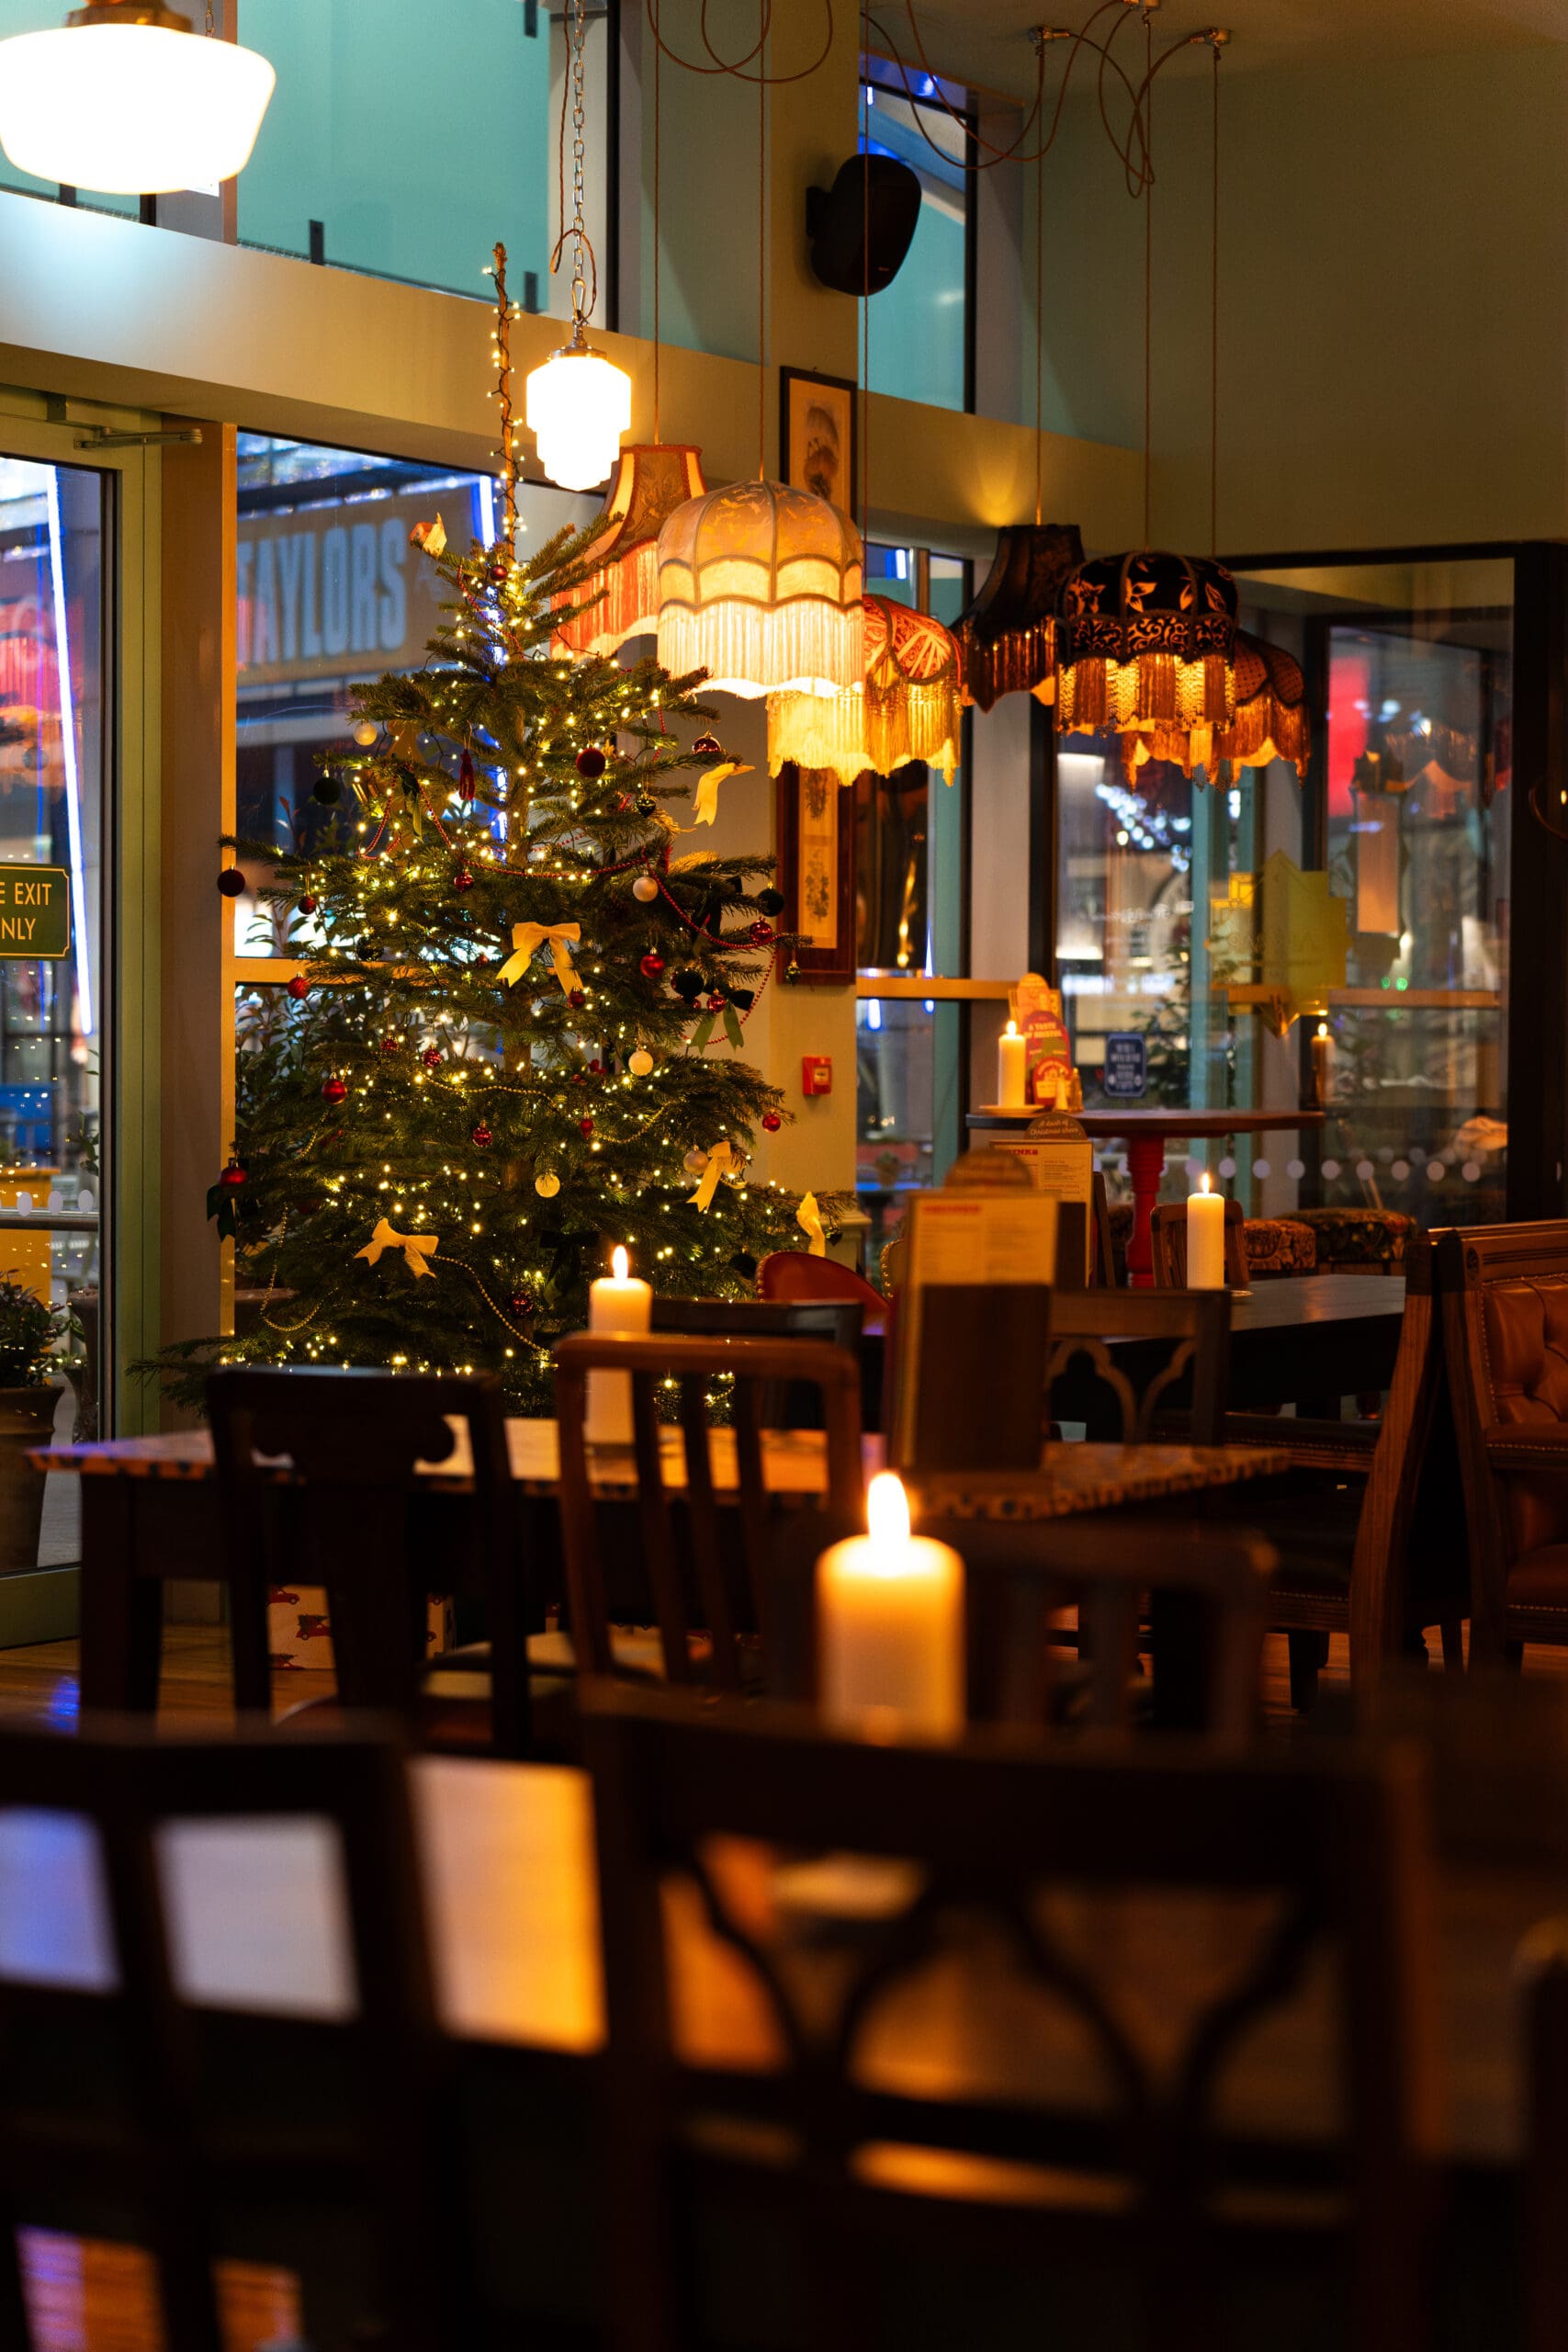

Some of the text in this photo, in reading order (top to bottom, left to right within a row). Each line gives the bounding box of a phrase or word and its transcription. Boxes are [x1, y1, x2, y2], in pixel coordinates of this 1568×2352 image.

[236, 518, 406, 663] TAYLORS
[15, 882, 52, 905] EXIT
[1034, 1022, 1056, 1031] TASTE
